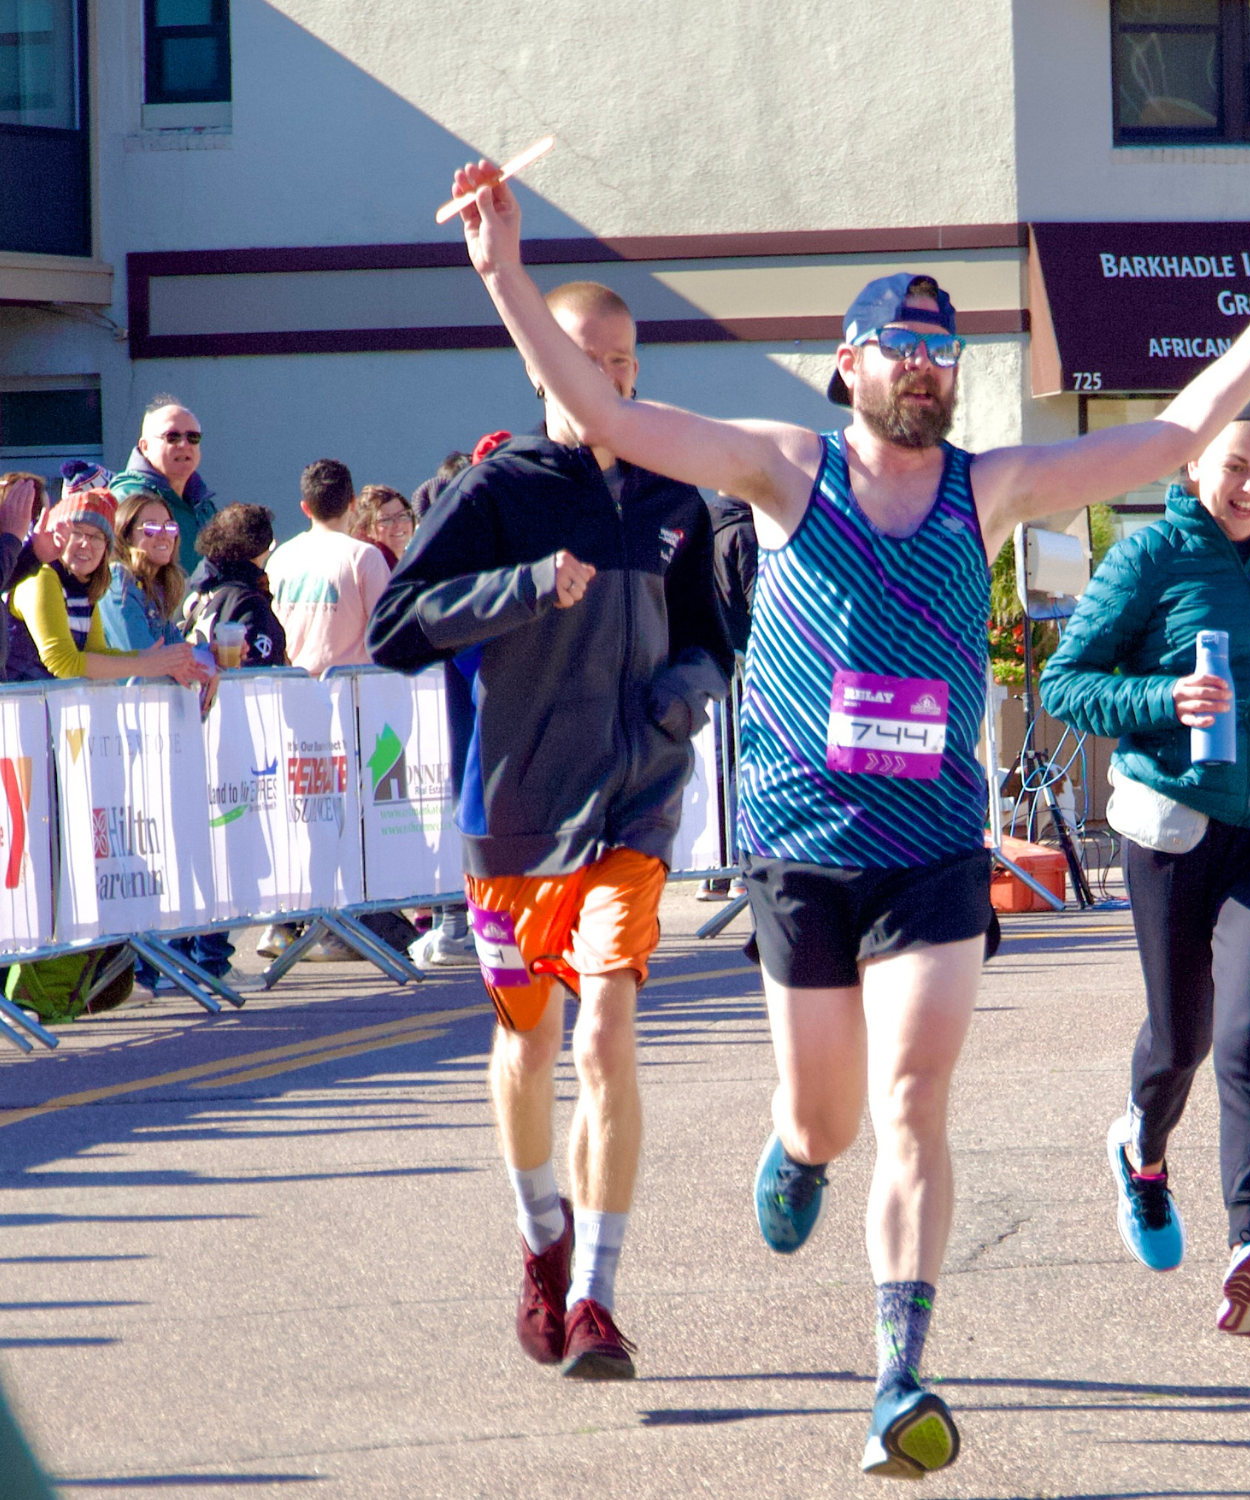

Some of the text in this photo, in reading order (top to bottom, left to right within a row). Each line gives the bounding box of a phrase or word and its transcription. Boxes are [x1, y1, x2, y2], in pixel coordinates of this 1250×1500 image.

[1100, 253, 1236, 278] BARKHADLE
[1072, 372, 1102, 391] 725
[843, 687, 894, 704] RELAY
[850, 721, 928, 747] 744
